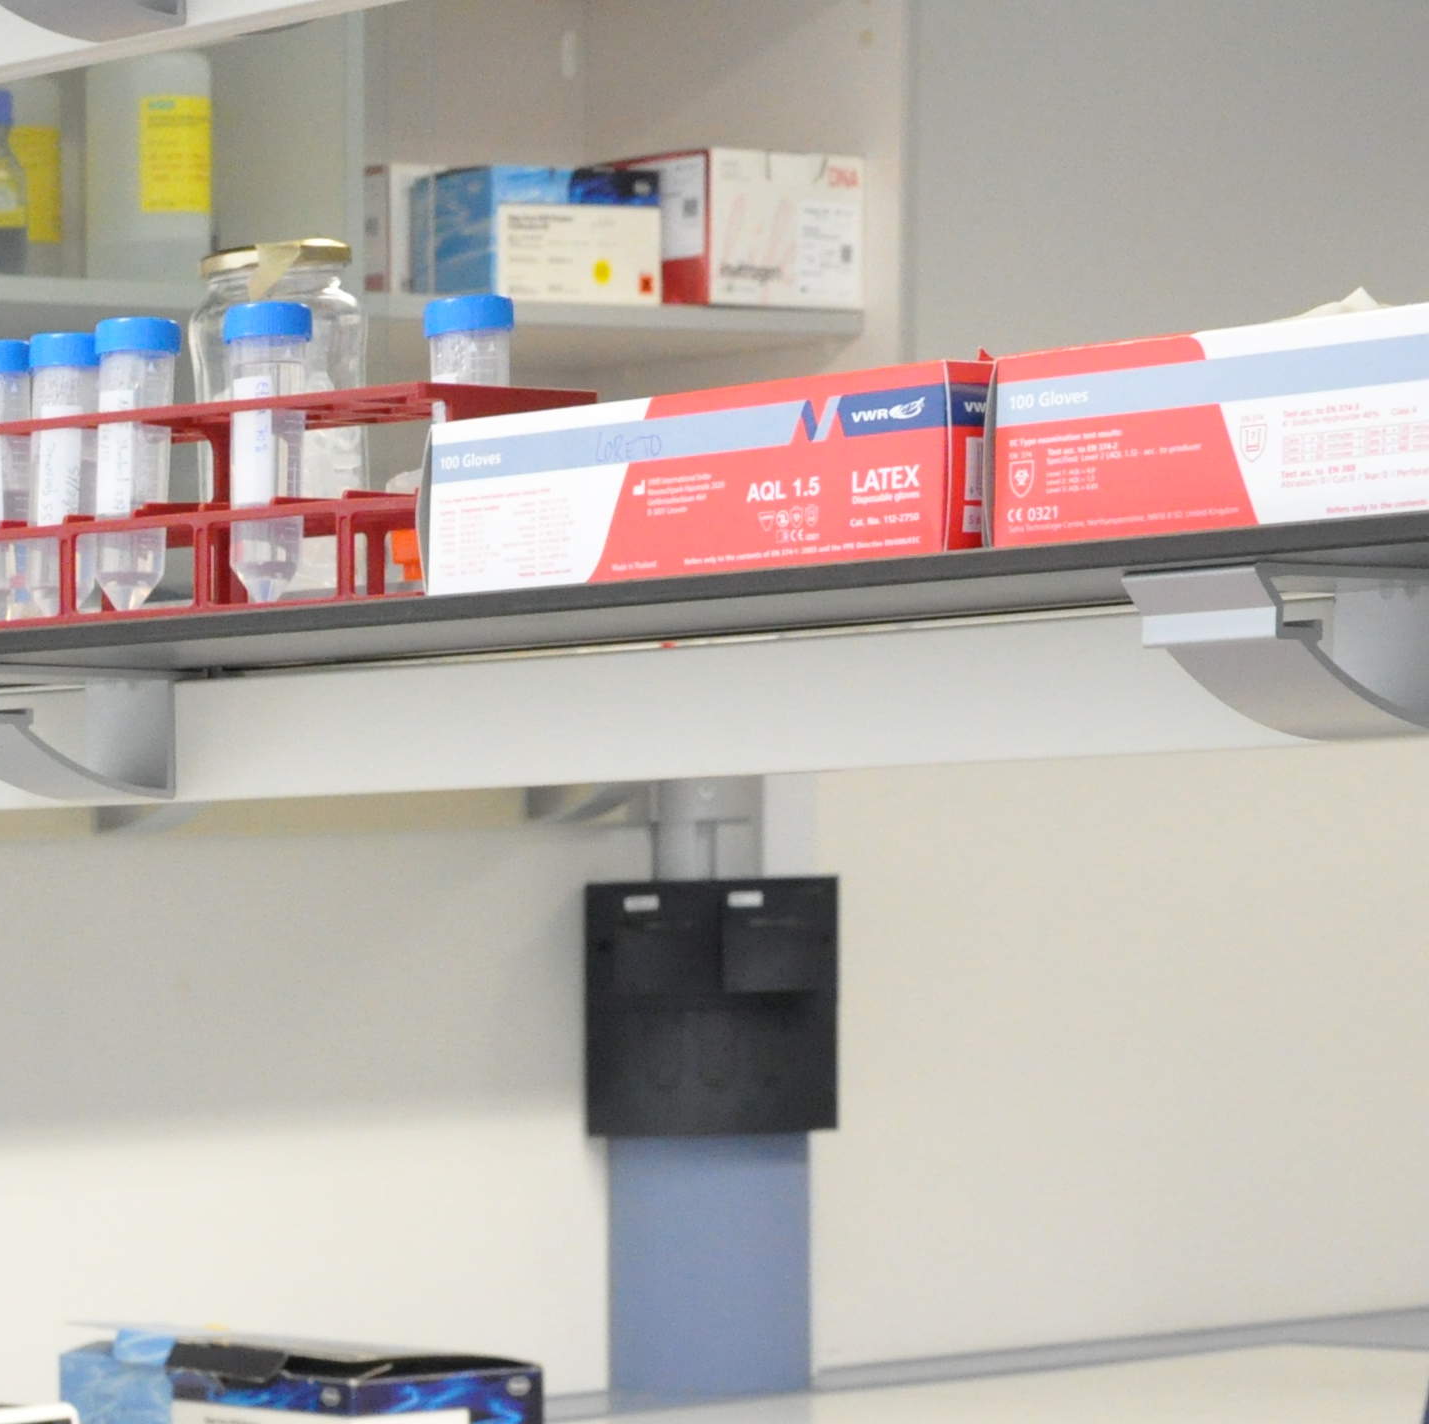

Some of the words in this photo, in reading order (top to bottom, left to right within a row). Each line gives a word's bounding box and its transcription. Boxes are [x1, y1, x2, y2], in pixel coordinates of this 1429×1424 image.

[964, 401, 987, 413] VW
[1009, 394, 1034, 410] 100
[1038, 390, 1089, 407] Gloves
[851, 408, 889, 423] VWR
[1283, 410, 1298, 418] Test
[595, 431, 663, 463] LORETO
[1009, 438, 1019, 448] EC
[1019, 438, 1037, 448] Type
[1037, 434, 1082, 445] examination
[1082, 431, 1097, 440] test
[1047, 448, 1062, 457] Test
[1077, 446, 1086, 454] to
[1086, 444, 1097, 453] EN
[1098, 441, 1119, 452] 374-2
[1081, 451, 1099, 462] Level
[1159, 445, 1168, 454] to
[1168, 443, 1202, 455] producer
[440, 455, 460, 470] 100
[463, 453, 501, 469] Gloves
[851, 464, 921, 493] LATEX
[1281, 470, 1297, 478] Test
[1328, 465, 1339, 474] EN
[746, 481, 787, 503] AQL
[793, 476, 821, 497] 1.5
[852, 492, 893, 505] Disposable
[893, 490, 921, 503] gloves
[1027, 506, 1059, 522] 0321
[1185, 508, 1207, 518] United
[1208, 506, 1239, 517] Kingdom
[1326, 506, 1349, 514] Refers
[1352, 504, 1368, 513] only
[1394, 499, 1427, 508] contents
[849, 517, 865, 528] Cat.
[867, 514, 881, 525] No.
[883, 511, 920, 524] 112-2750
[684, 557, 703, 566] Refers
[703, 555, 717, 565] only
[717, 555, 725, 563] to
[725, 554, 736, 562] the
[736, 551, 763, 561] contents
[762, 550, 770, 559] of
[770, 549, 781, 558] EN
[818, 545, 831, 553] and
[831, 544, 842, 552] the
[855, 540, 884, 550] Directive
[611, 563, 627, 572] Made
[634, 559, 658, 569] Thailand
